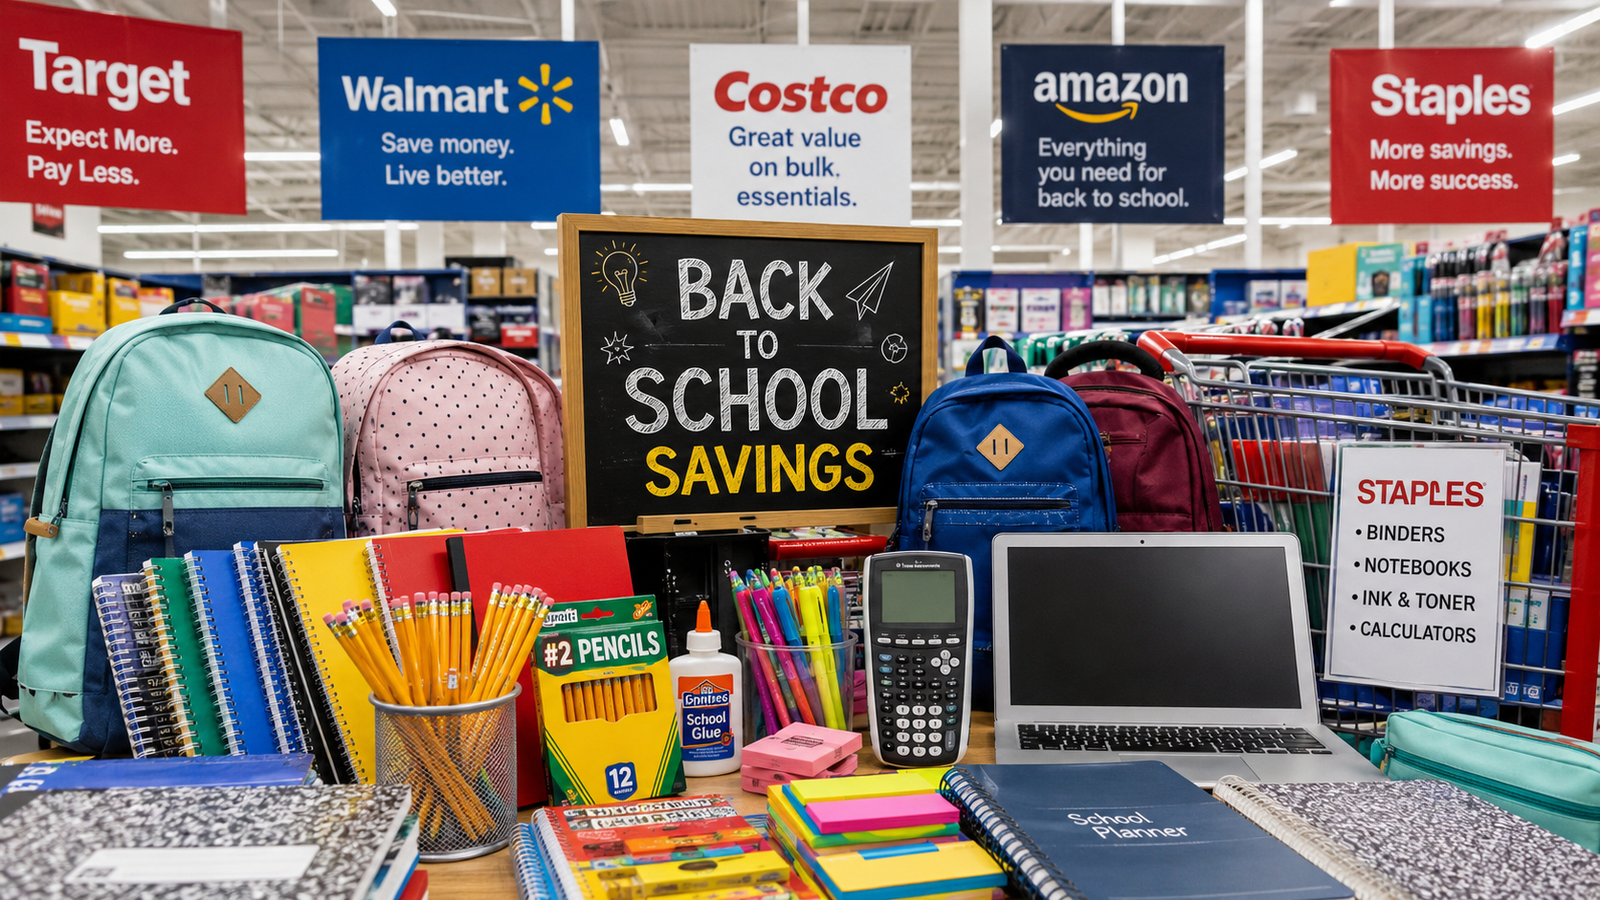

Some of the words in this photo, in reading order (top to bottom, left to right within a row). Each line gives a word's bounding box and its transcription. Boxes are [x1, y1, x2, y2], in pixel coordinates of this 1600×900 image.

[18, 37, 191, 112] Target
[341, 75, 509, 114] Walmart
[714, 70, 888, 114] Costco
[1033, 71, 1188, 103] amazon
[1370, 73, 1531, 125] Staples
[26, 119, 109, 151] Expect
[114, 127, 178, 155] More.
[381, 132, 434, 154] Save
[440, 138, 514, 159] money.
[729, 125, 794, 147] Great
[801, 126, 861, 148] value
[1038, 137, 1147, 162] Everything
[1370, 138, 1425, 160] More
[1430, 138, 1513, 164] savings.
[27, 154, 73, 186] Pay
[79, 158, 140, 185] Less.
[385, 164, 430, 185] Live
[436, 164, 507, 186] better.
[749, 161, 778, 177] on
[786, 156, 841, 177] bulk.
[1038, 166, 1075, 186] you
[1081, 162, 1132, 182] need
[1137, 162, 1167, 182] for
[1370, 169, 1425, 191] More
[1430, 173, 1519, 190] success.
[737, 186, 857, 207] essentials.
[1038, 187, 1087, 208] back
[1092, 189, 1113, 207] to
[1119, 187, 1189, 207] school.
[677, 257, 834, 321] BACK
[736, 329, 779, 360] TO
[625, 367, 888, 434] SCHOOL
[645, 442, 875, 497] SAVINGS
[1366, 524, 1445, 543] BINDERS
[1364, 557, 1472, 578] NOTEBOOKS
[1362, 589, 1393, 607] INK
[1397, 591, 1410, 608] &
[1415, 592, 1476, 612] TONER
[1360, 620, 1476, 644] CALCULATORS
[544, 640, 573, 668] #2
[577, 630, 661, 664] PENCILS
[686, 710, 726, 726] School
[691, 726, 722, 740] Glue
[608, 766, 633, 789] 12
[1067, 811, 1151, 826] School
[1091, 825, 1188, 840] Planner
